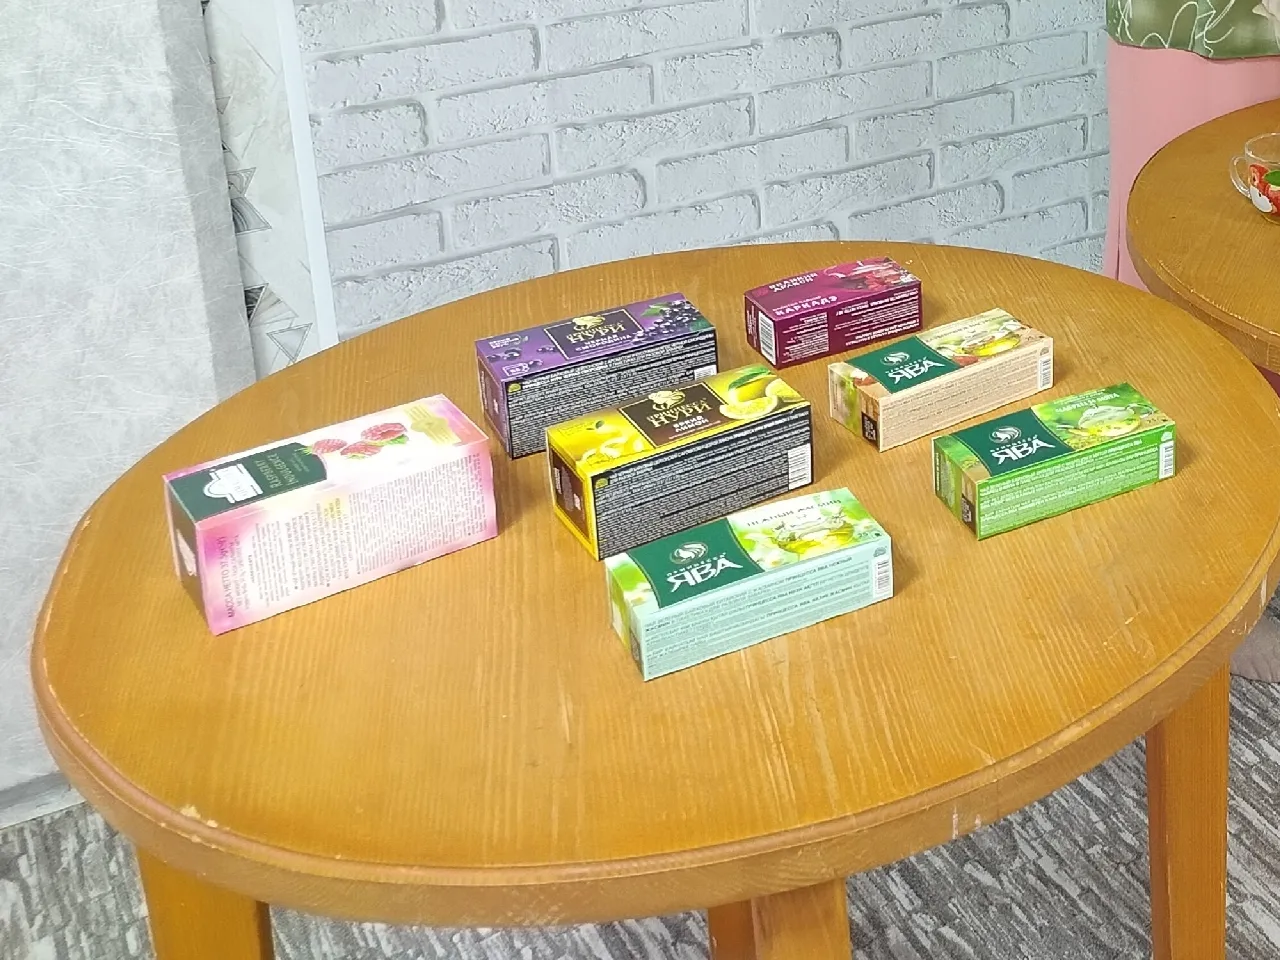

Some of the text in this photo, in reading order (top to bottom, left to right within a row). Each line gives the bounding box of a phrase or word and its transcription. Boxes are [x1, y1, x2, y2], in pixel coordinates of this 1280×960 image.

[888, 359, 946, 385] ЯВА
[649, 402, 713, 428] НУРИ
[991, 438, 1056, 465] ЯВА
[666, 557, 744, 593] ЯВА
